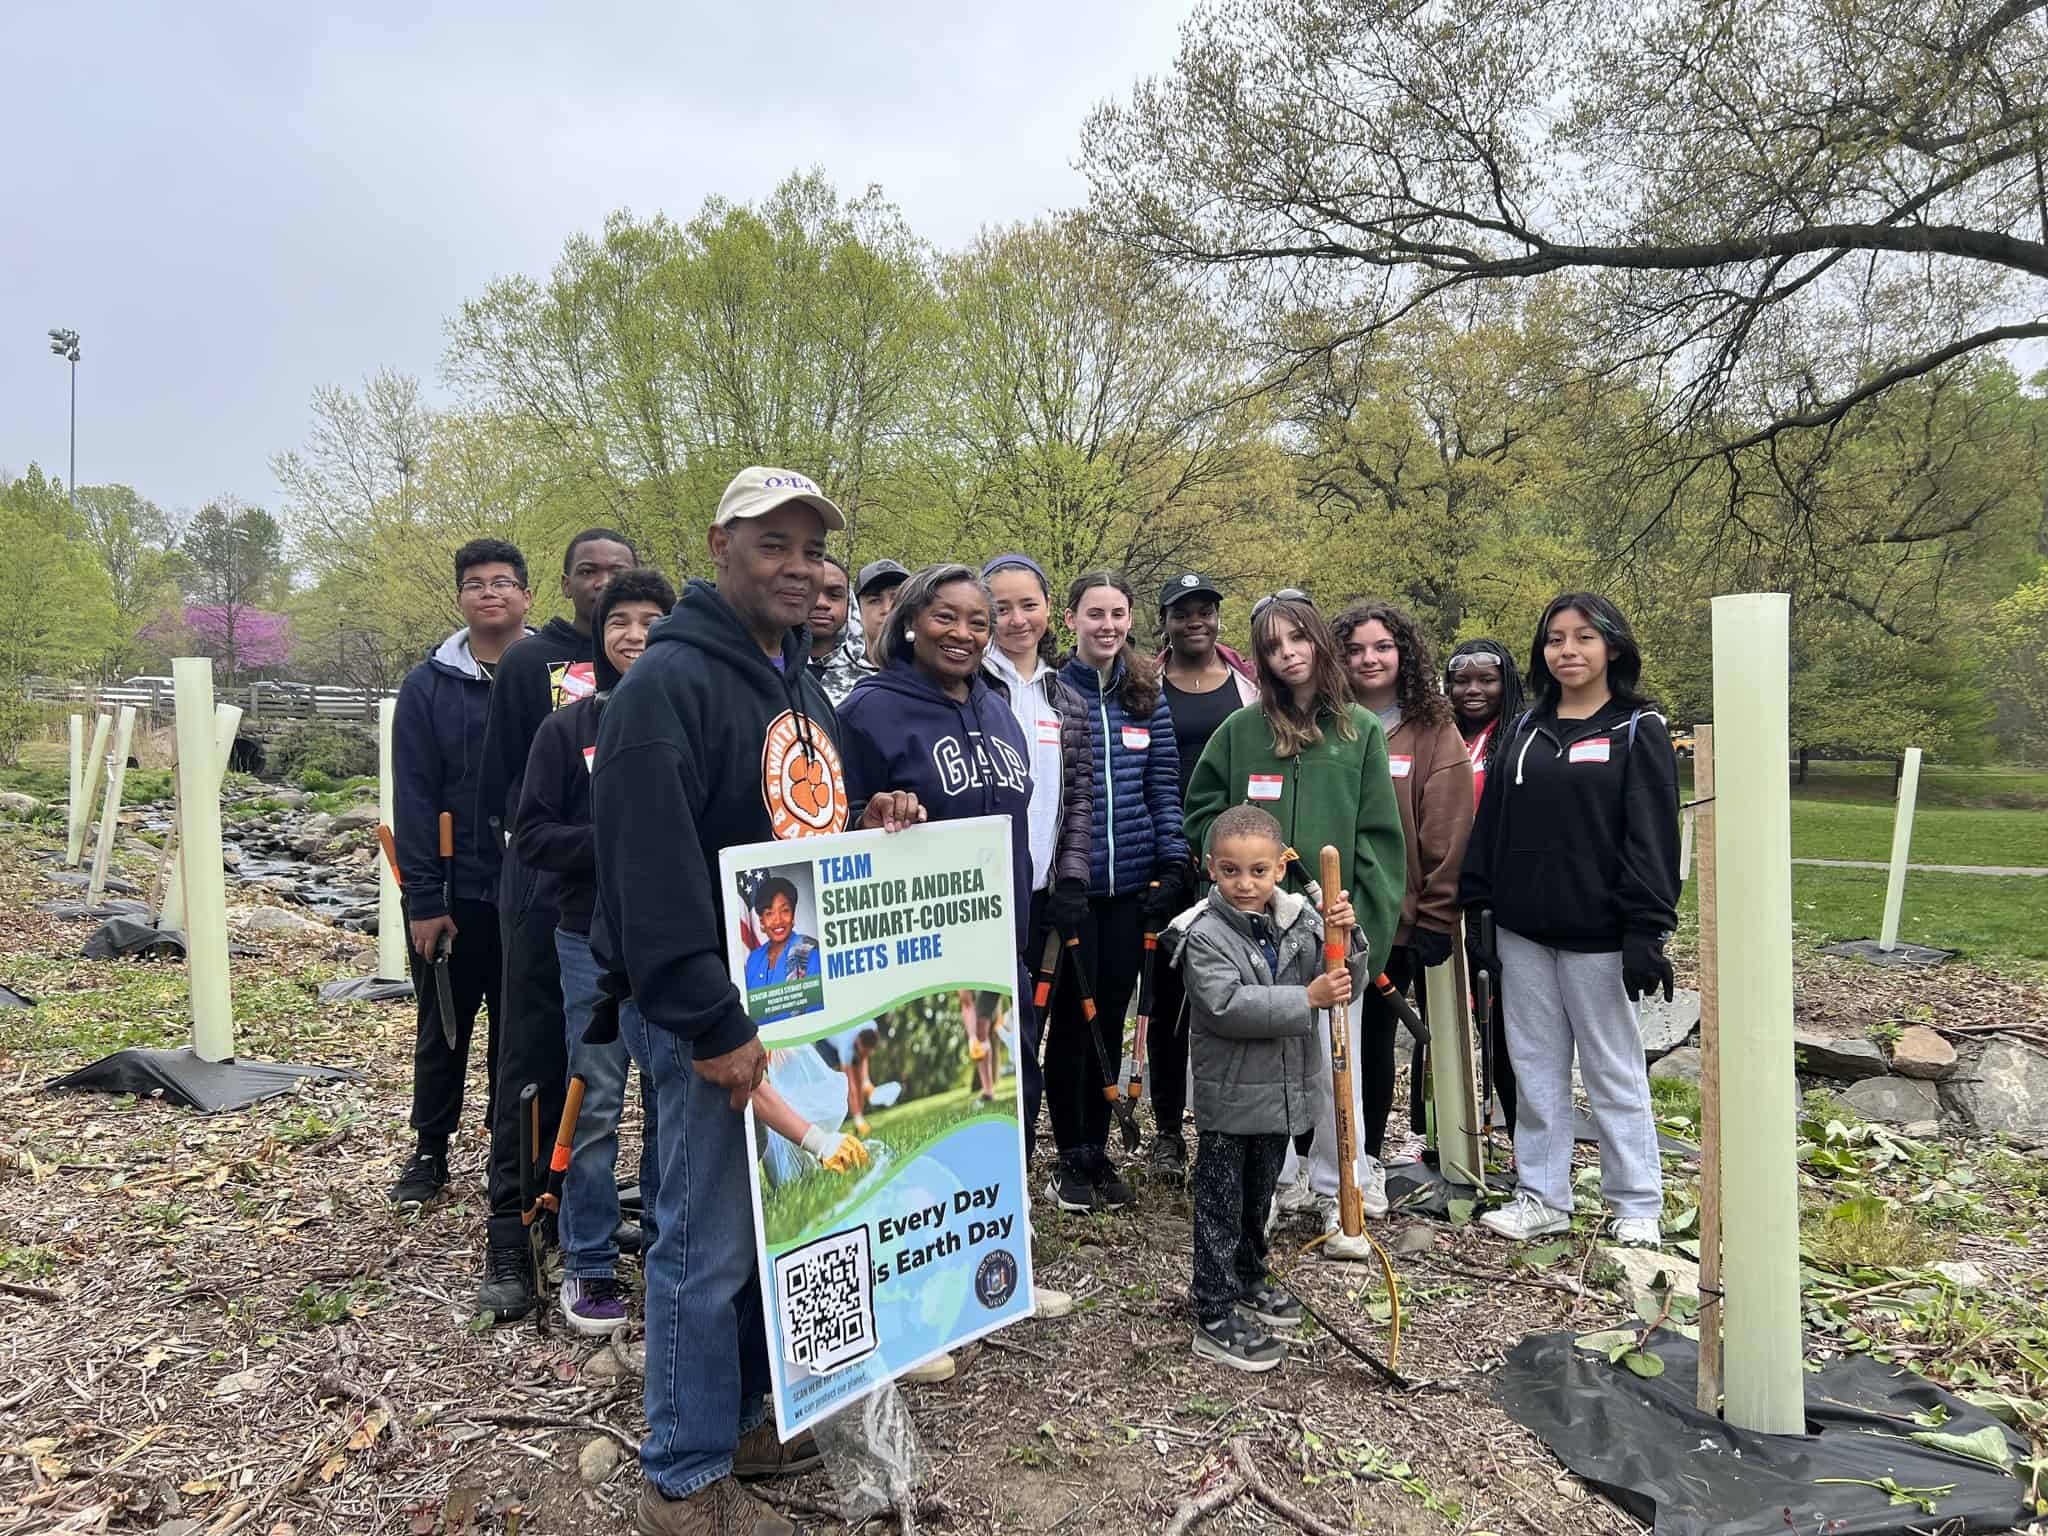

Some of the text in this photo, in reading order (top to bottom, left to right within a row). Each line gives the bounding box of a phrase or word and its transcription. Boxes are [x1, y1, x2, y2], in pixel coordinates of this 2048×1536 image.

[933, 733, 1027, 796] GAP
[819, 853, 872, 884] TEAM
[822, 868, 985, 916] SENATOR ANDREA
[824, 894, 1003, 948] STEWART-COUSINS
[827, 933, 943, 980] MEETS HERE
[878, 1183, 1000, 1244] Every Day
[872, 1260, 890, 1287] is
[896, 1231, 961, 1275] Earth
[968, 1214, 1014, 1246] Day
